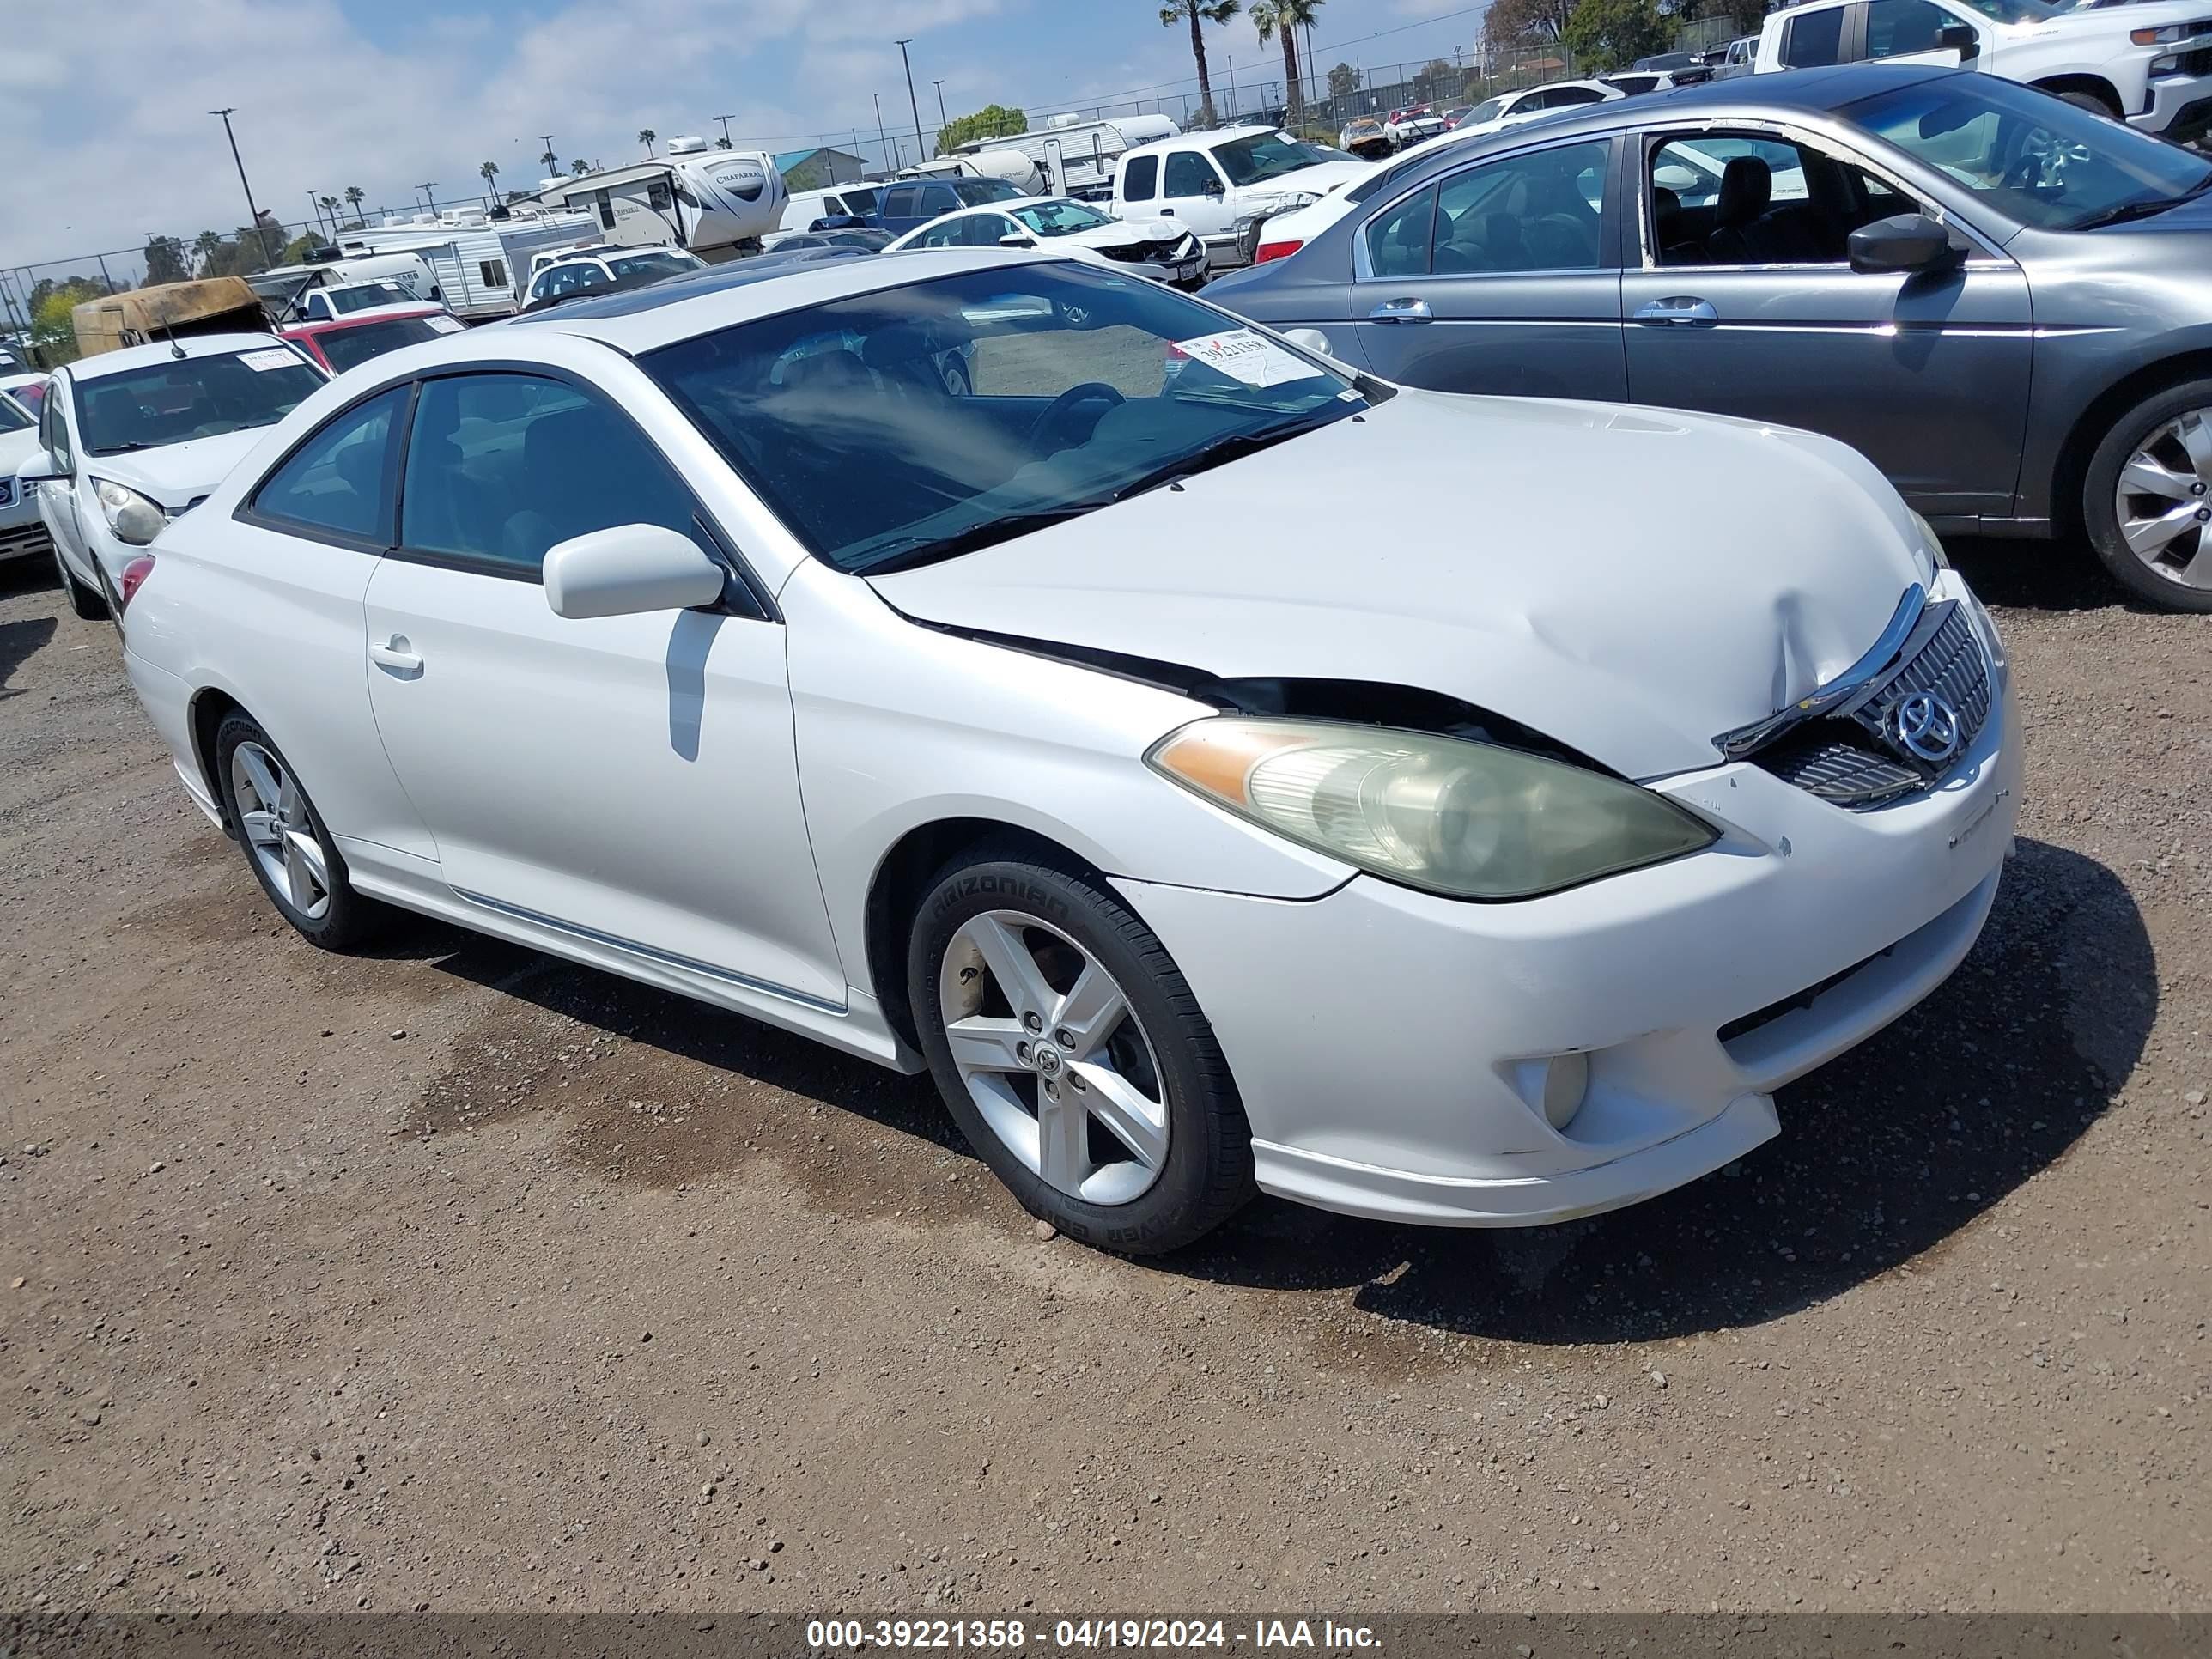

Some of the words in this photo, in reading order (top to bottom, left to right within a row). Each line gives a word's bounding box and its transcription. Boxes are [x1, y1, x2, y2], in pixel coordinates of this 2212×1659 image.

[715, 170, 763, 185] CHAPARRAL
[1200, 340, 1267, 361] 39221358
[932, 875, 1070, 920] ARIZONIAN
